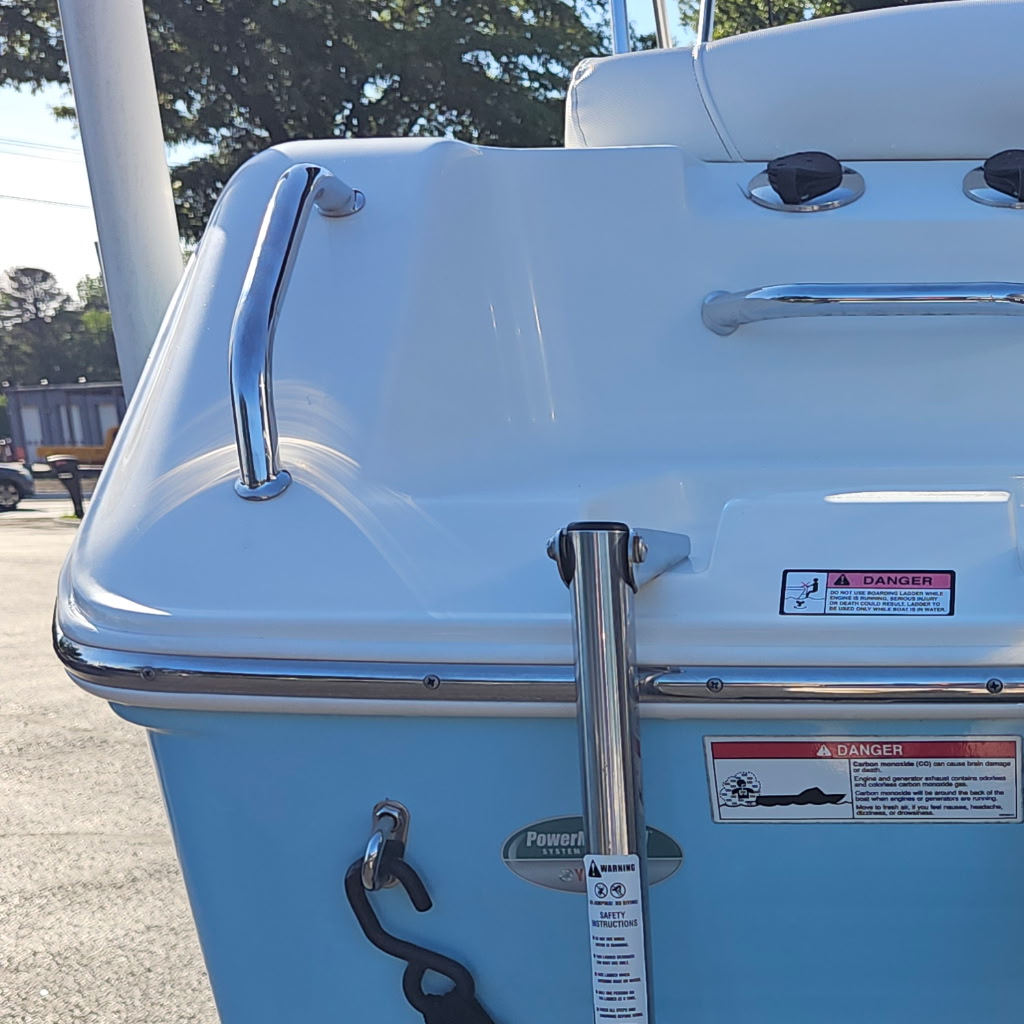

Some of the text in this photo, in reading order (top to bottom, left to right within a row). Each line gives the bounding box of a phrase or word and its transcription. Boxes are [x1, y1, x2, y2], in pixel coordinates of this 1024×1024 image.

[864, 576, 933, 586] DANGER
[838, 744, 903, 756] DANGER
[600, 864, 636, 873] WARNING
[600, 911, 626, 919] SAFETY
